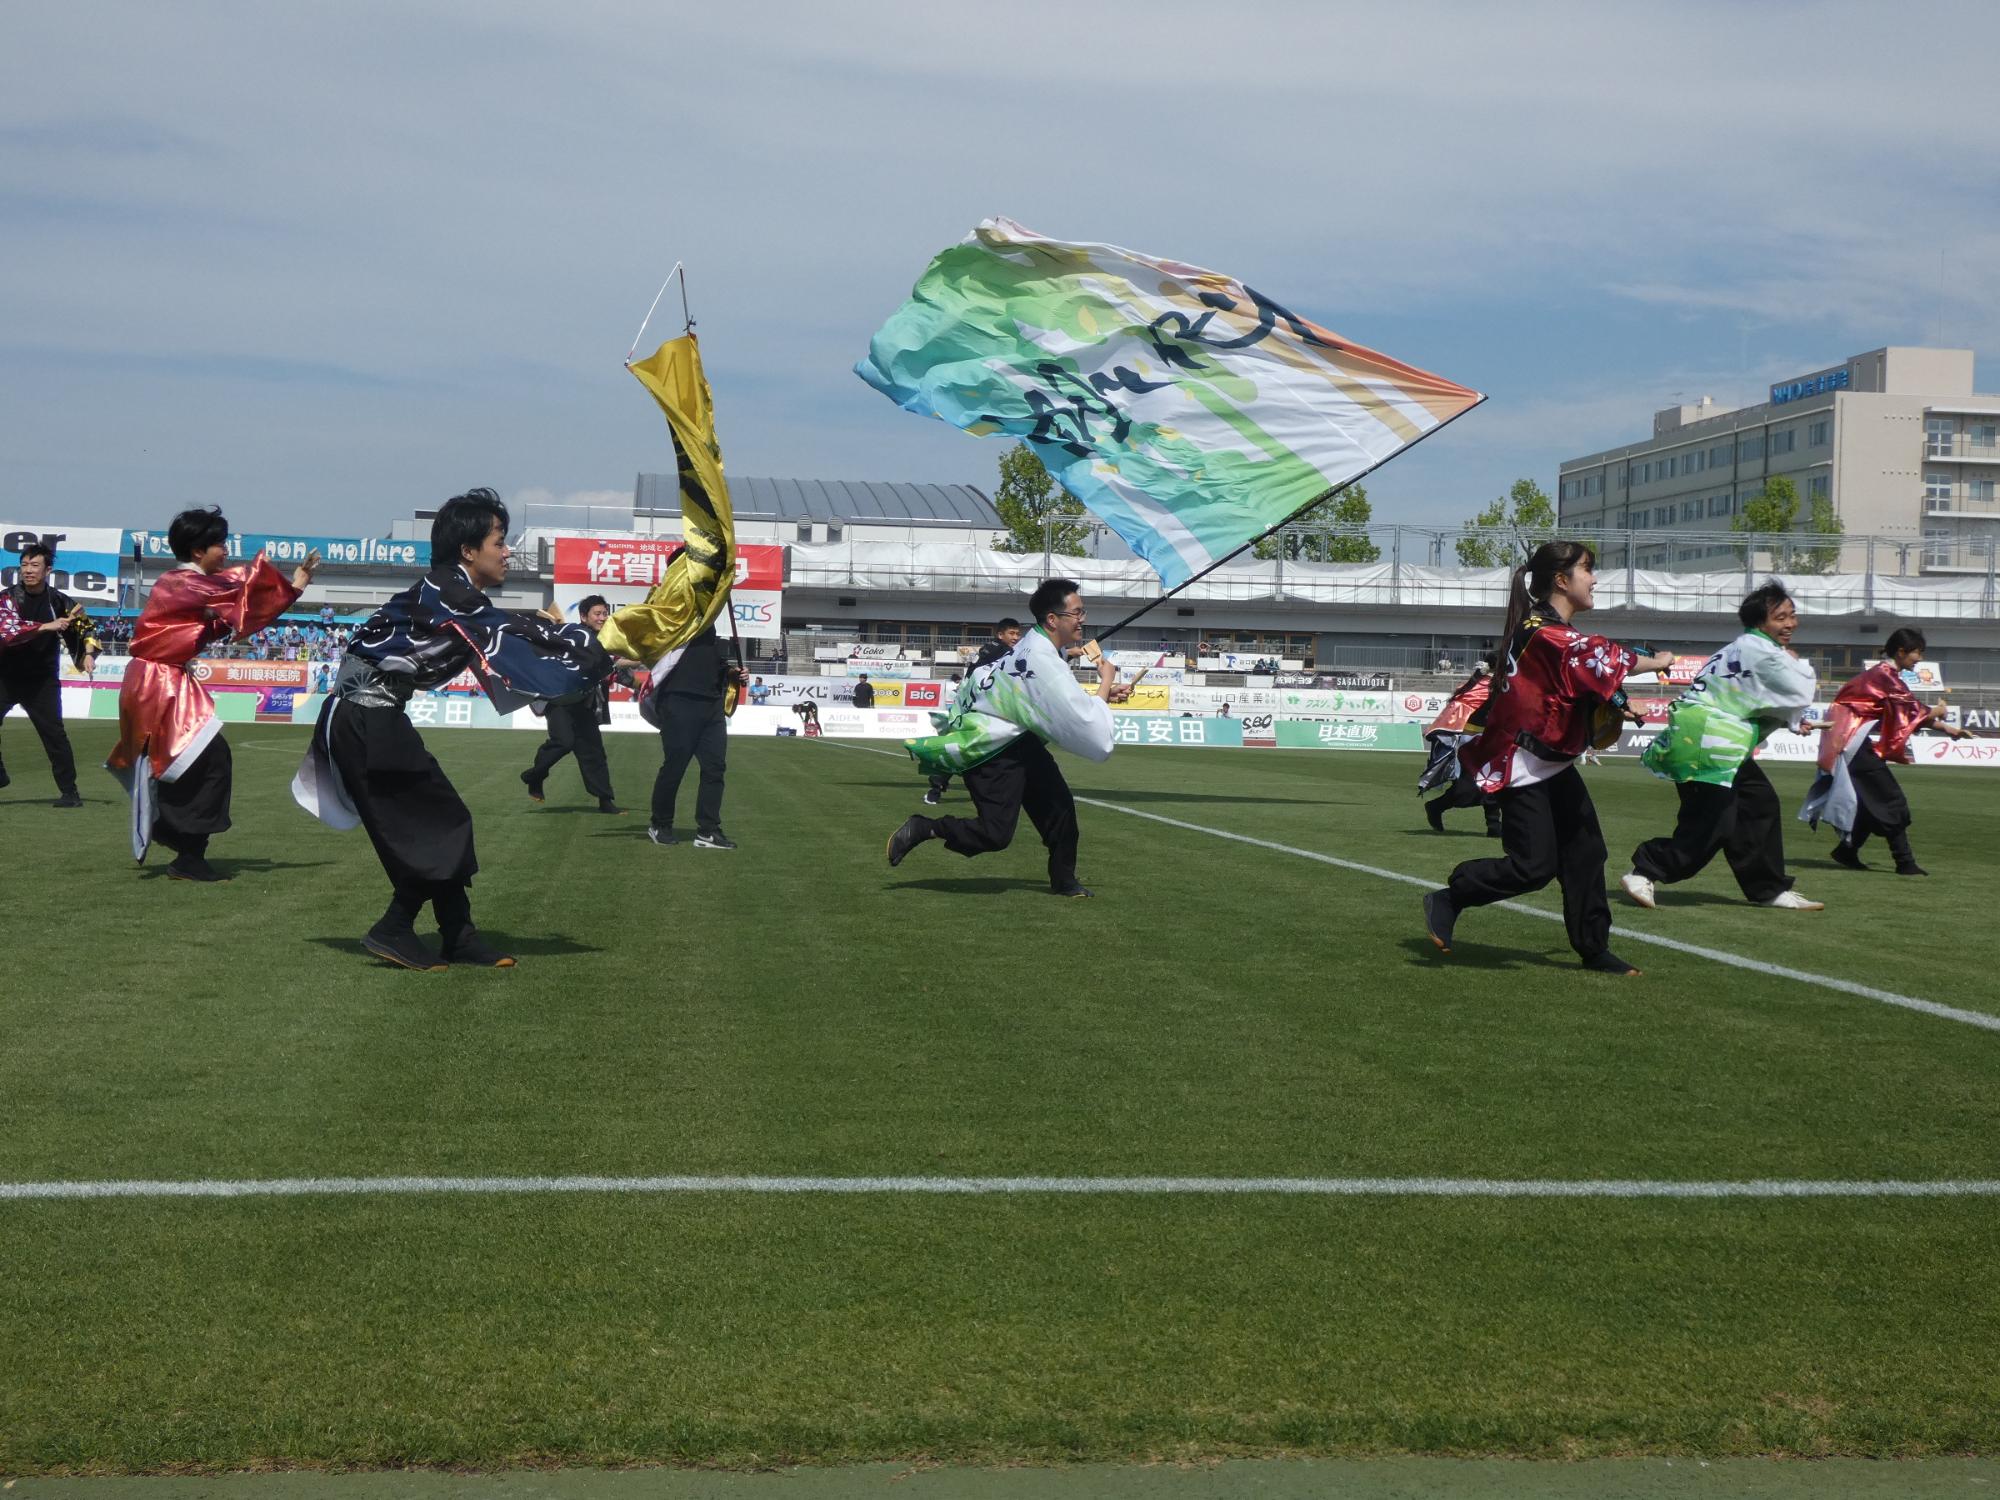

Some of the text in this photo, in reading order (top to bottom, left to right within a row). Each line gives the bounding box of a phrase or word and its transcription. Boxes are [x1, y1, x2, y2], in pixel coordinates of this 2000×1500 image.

[265, 540, 306, 559] non
[328, 537, 416, 563] mollare
[226, 667, 301, 682] 美川眼科医院
[410, 700, 473, 724] 安田
[1114, 717, 1205, 744] 治安田
